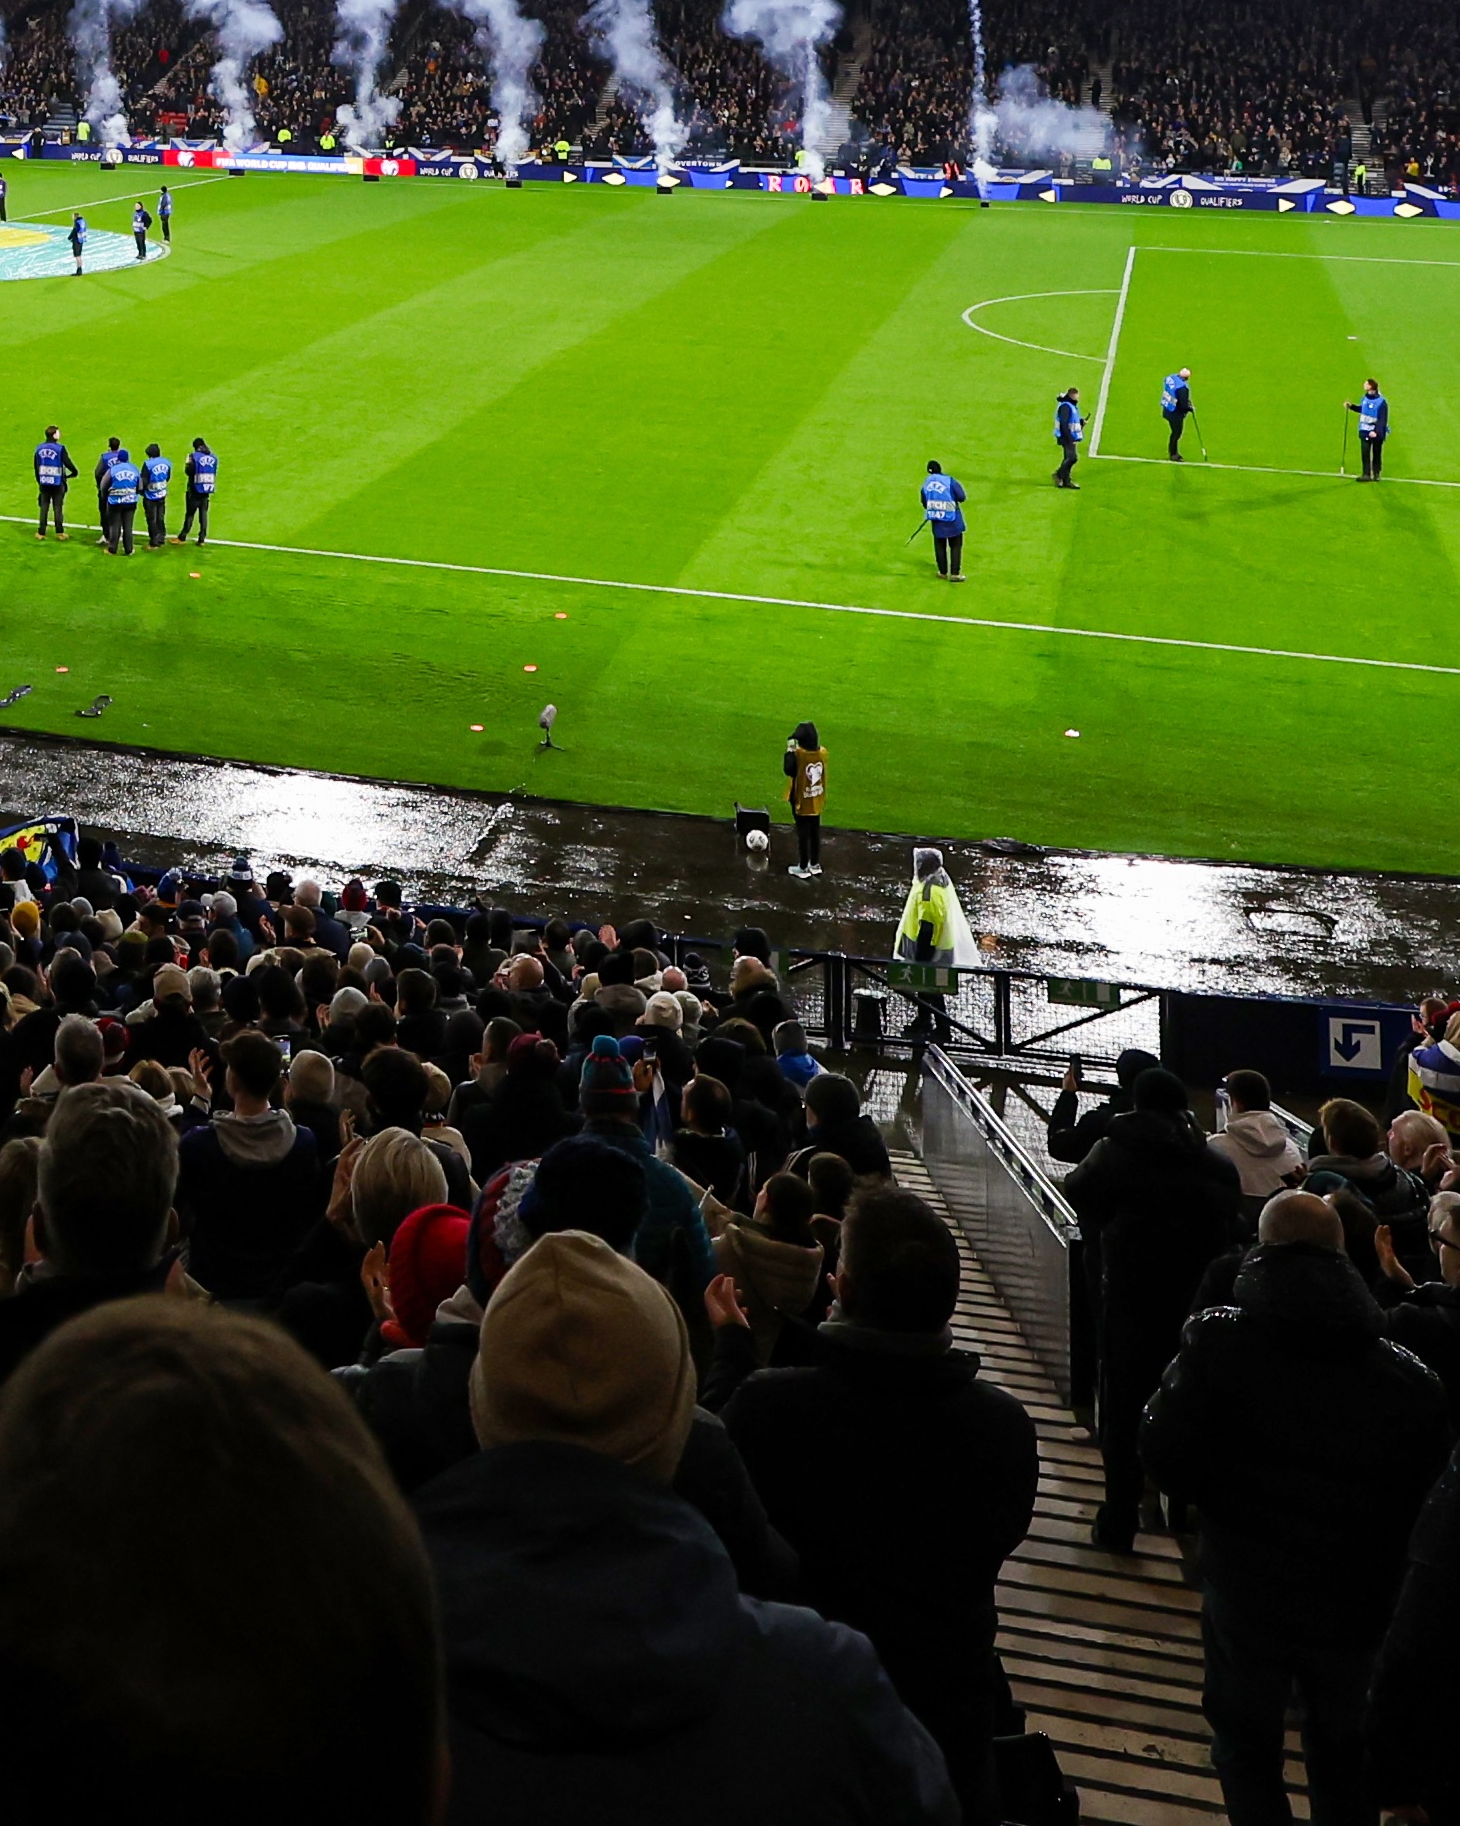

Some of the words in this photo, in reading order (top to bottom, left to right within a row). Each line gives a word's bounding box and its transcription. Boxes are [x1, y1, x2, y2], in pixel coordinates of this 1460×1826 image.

[216, 158, 236, 167] FIFA
[236, 159, 269, 168] WORLD
[269, 160, 287, 169] CUP
[307, 162, 359, 172] QUALIFIERS
[1121, 194, 1145, 204] WORLD
[1147, 194, 1163, 205] CUP
[1200, 197, 1243, 208] QUALIFIERS
